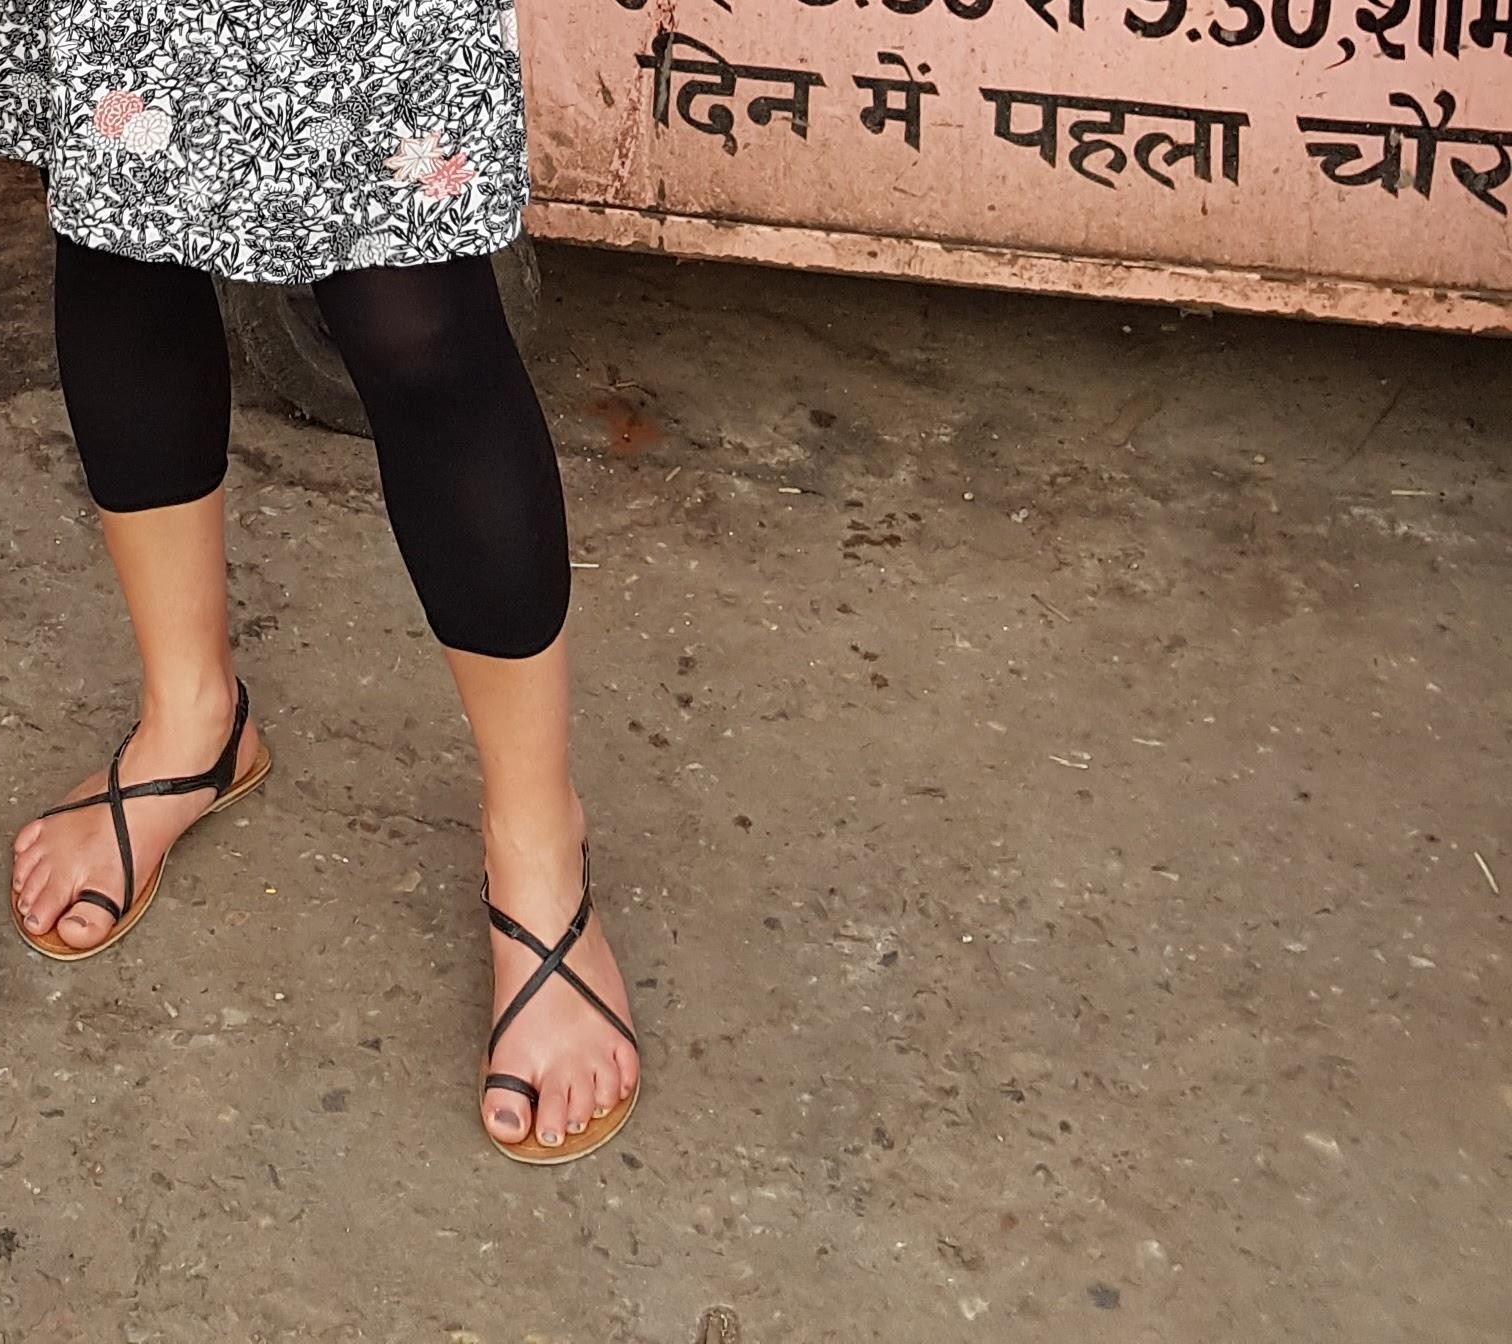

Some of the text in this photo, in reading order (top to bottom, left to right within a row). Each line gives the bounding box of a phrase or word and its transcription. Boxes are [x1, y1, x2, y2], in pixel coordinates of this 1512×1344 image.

[634, 30, 828, 157] दिन
[853, 51, 939, 151] में
[981, 85, 1250, 187] पहला
